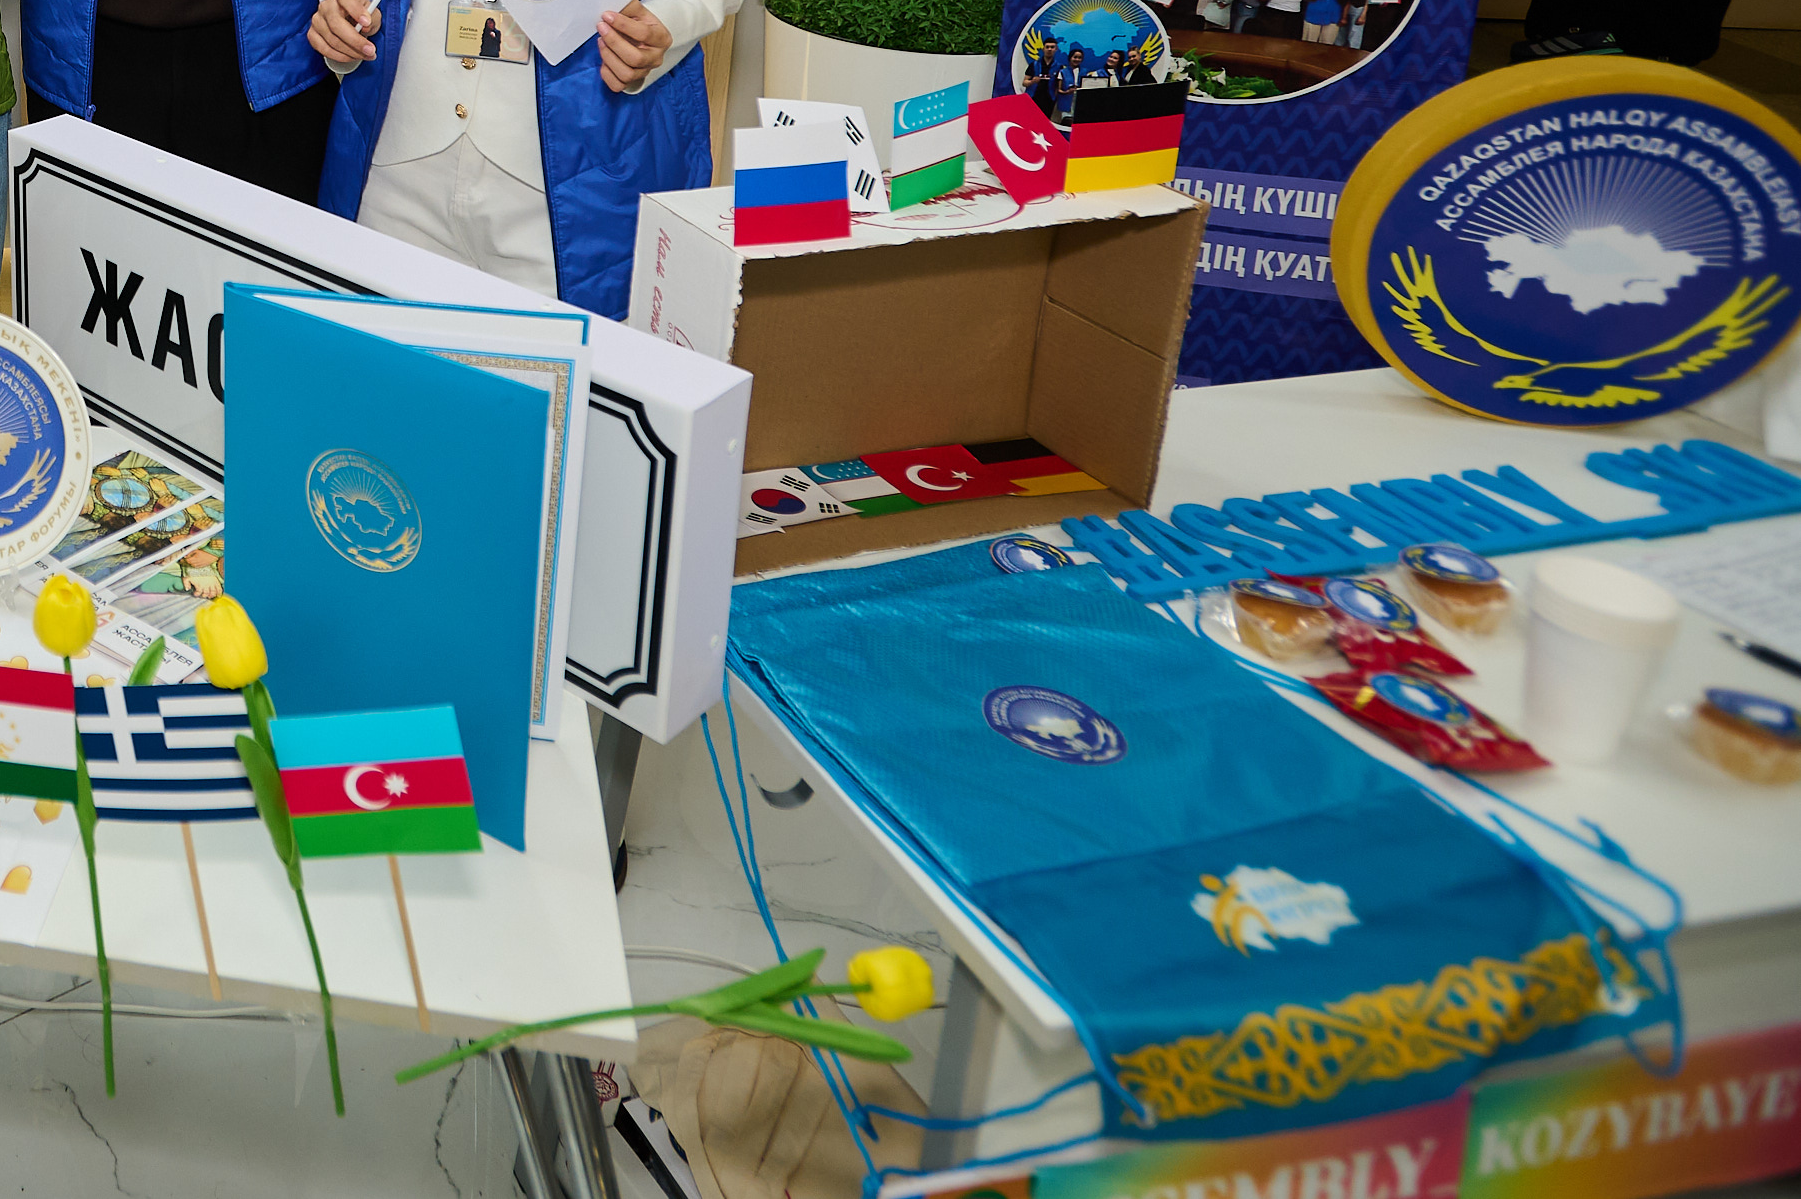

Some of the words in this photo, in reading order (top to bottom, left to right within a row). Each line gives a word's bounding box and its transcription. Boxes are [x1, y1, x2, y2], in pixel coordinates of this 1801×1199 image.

[1418, 117, 1562, 204] QAZAQSTAN
[1569, 108, 1669, 128] HALQY
[1252, 185, 1338, 220] КҮШІ
[1435, 141, 1566, 232] АССАМБЛЕЯ
[1571, 134, 1681, 158] НАРОДА
[1681, 149, 1767, 262] КАЗАХСТАНА
[35, 354, 83, 444] МЕКЕНІ»
[29, 481, 78, 544] ФОРУМЫ
[120, 624, 194, 667] АССАБЛЕЯ
